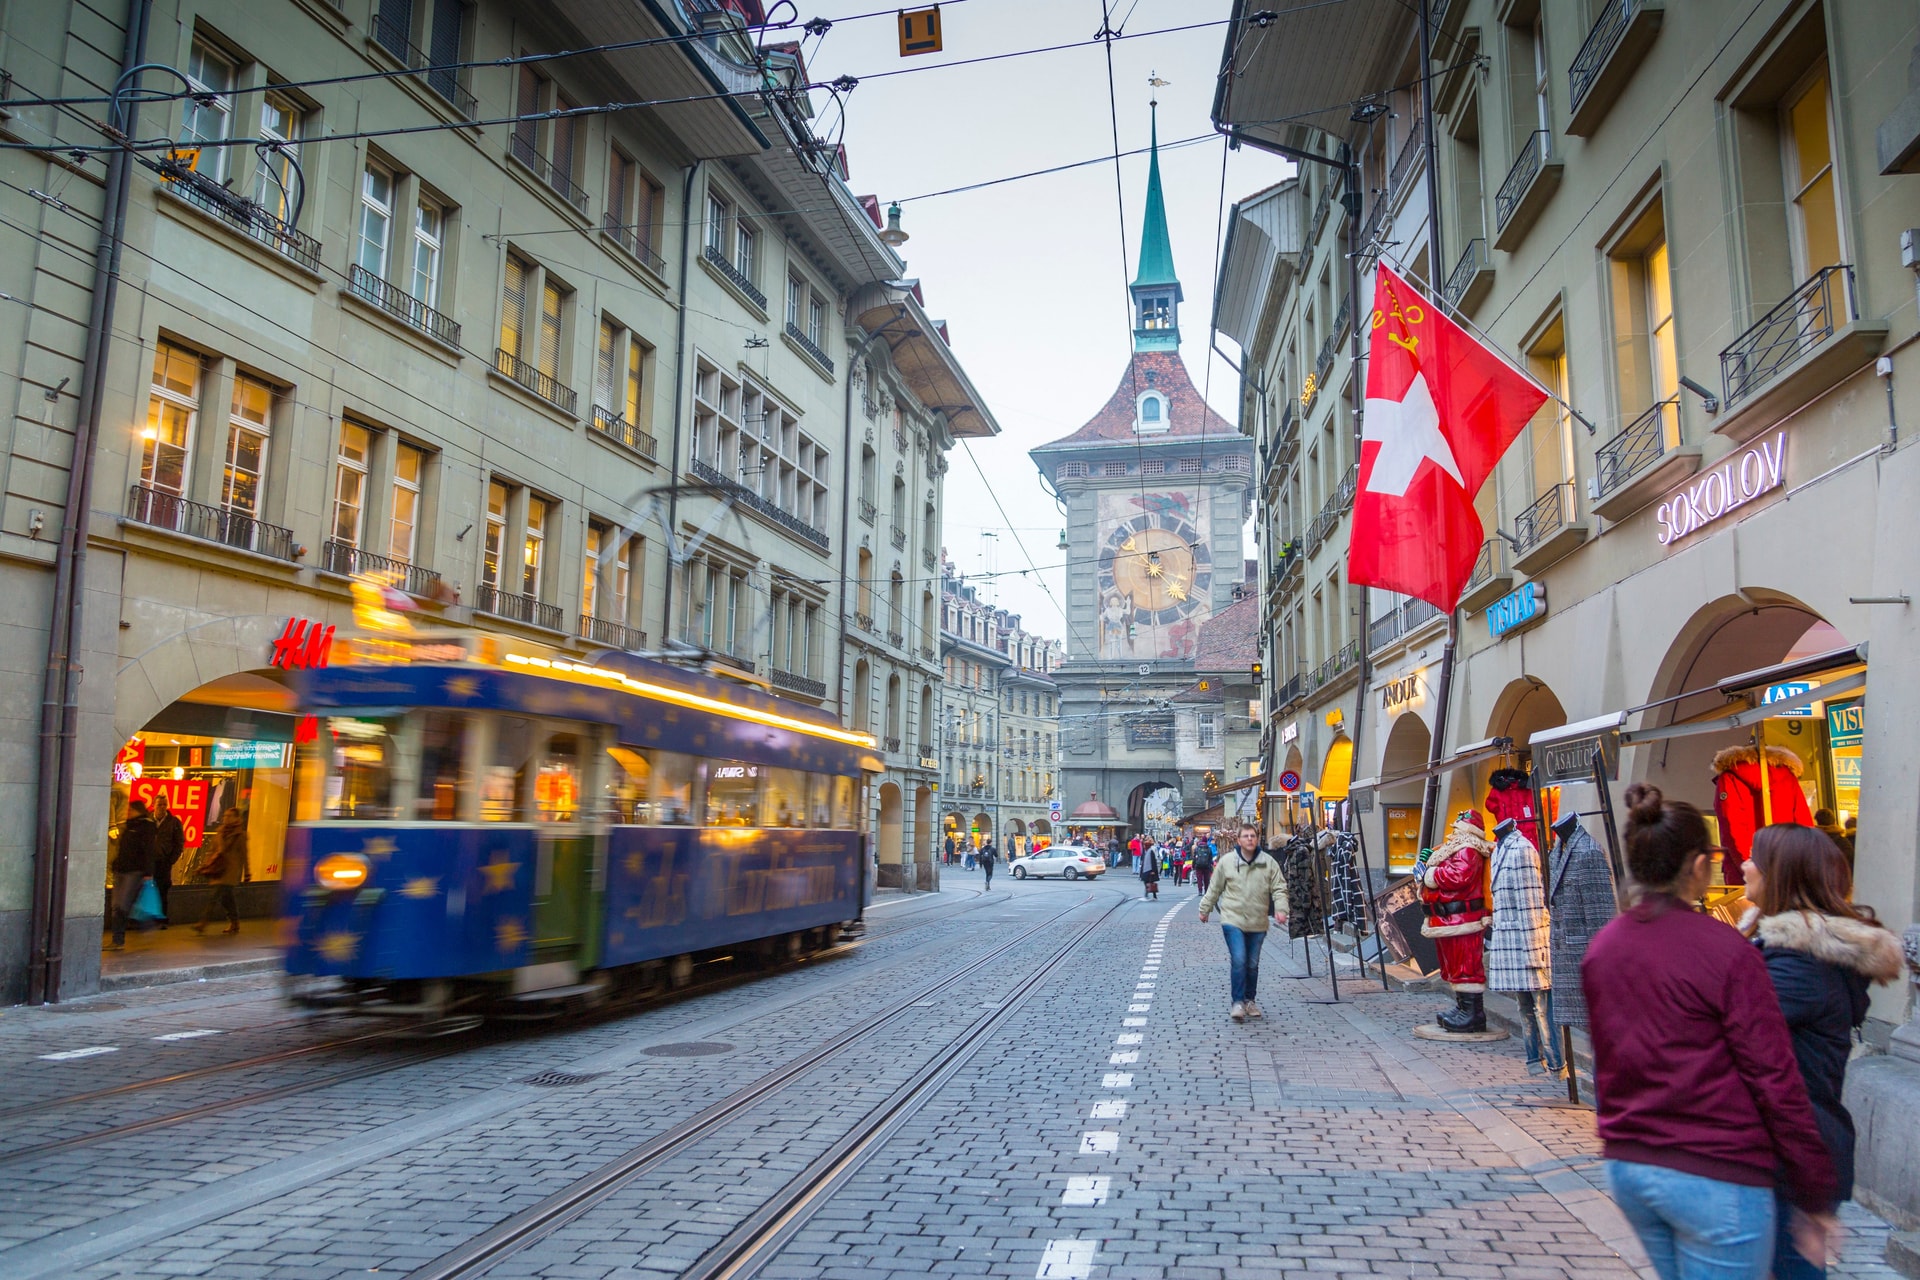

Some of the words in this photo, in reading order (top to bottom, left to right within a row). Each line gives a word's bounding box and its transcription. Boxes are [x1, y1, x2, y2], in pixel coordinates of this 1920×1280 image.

[1657, 432, 1786, 545] SOKOLOV
[1485, 581, 1537, 638] VISILAB
[1382, 674, 1420, 709] ANOUK
[138, 783, 201, 810] SALE
